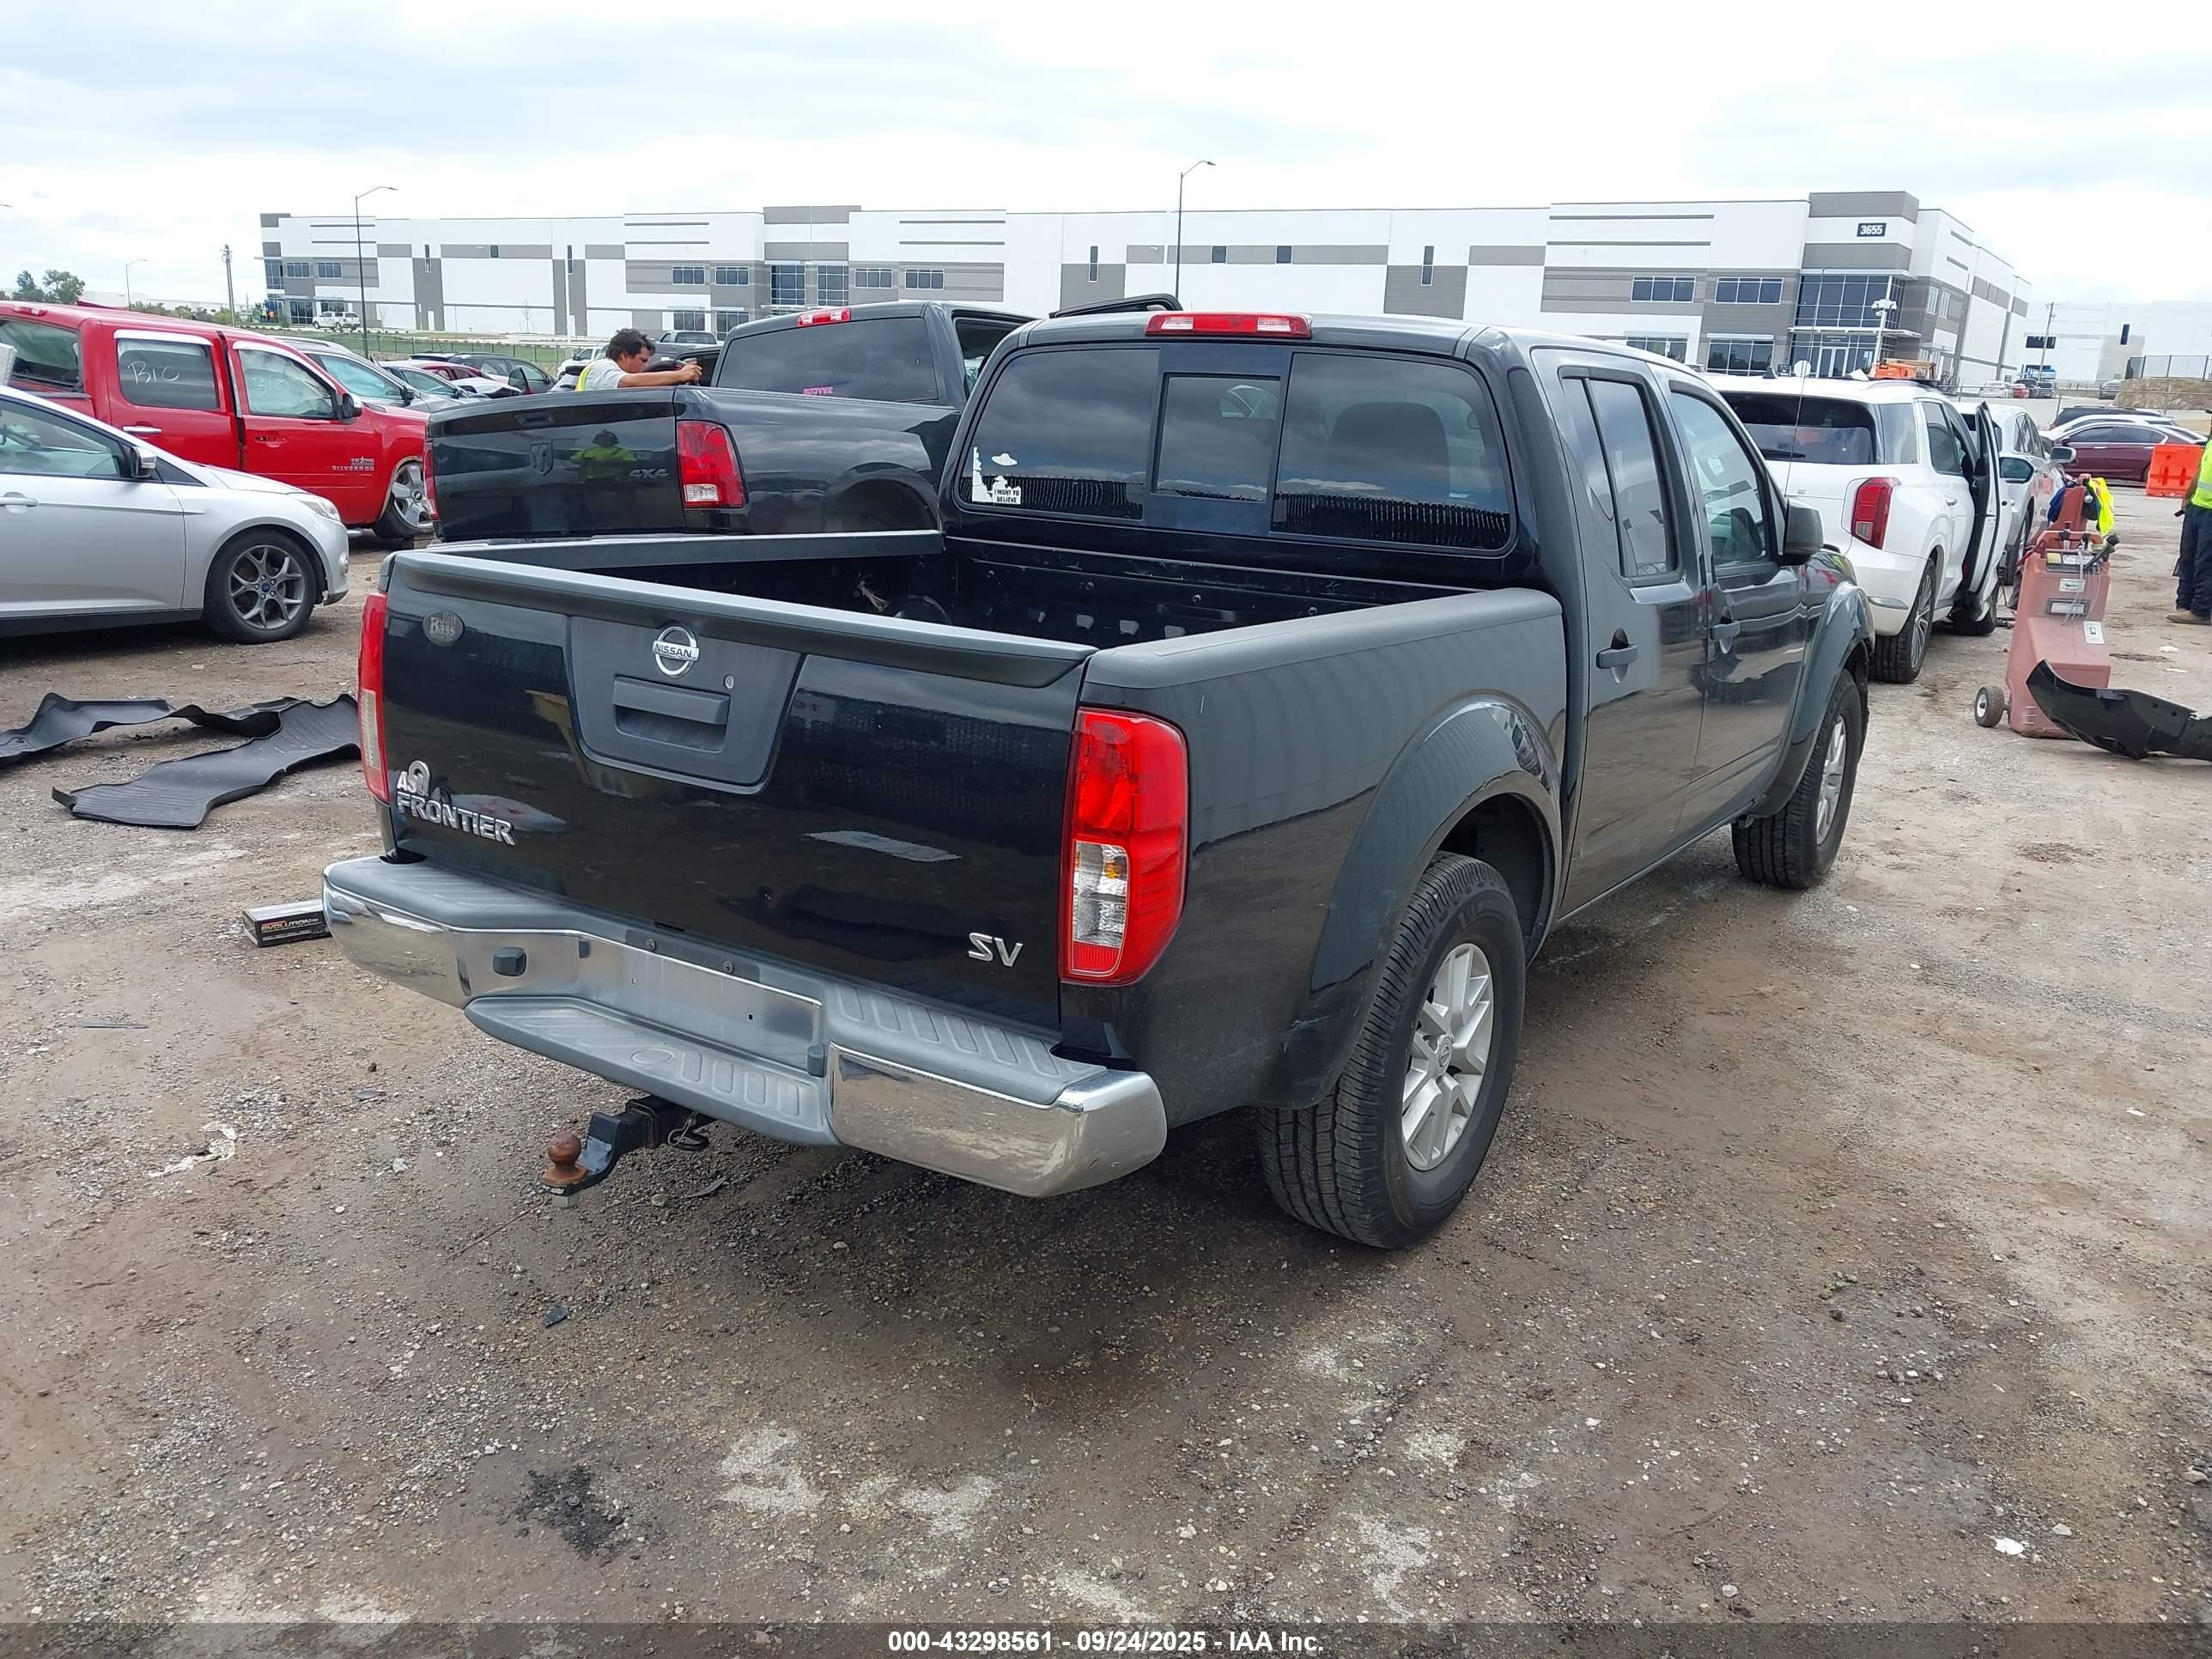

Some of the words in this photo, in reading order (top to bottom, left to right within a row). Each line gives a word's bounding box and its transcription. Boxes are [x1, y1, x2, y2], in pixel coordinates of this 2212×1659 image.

[1860, 224, 1884, 235] 3655
[429, 617, 455, 637] Bass
[655, 643, 692, 658] NISSAN
[397, 791, 515, 846] FRONTIER
[968, 933, 1024, 967] SV
